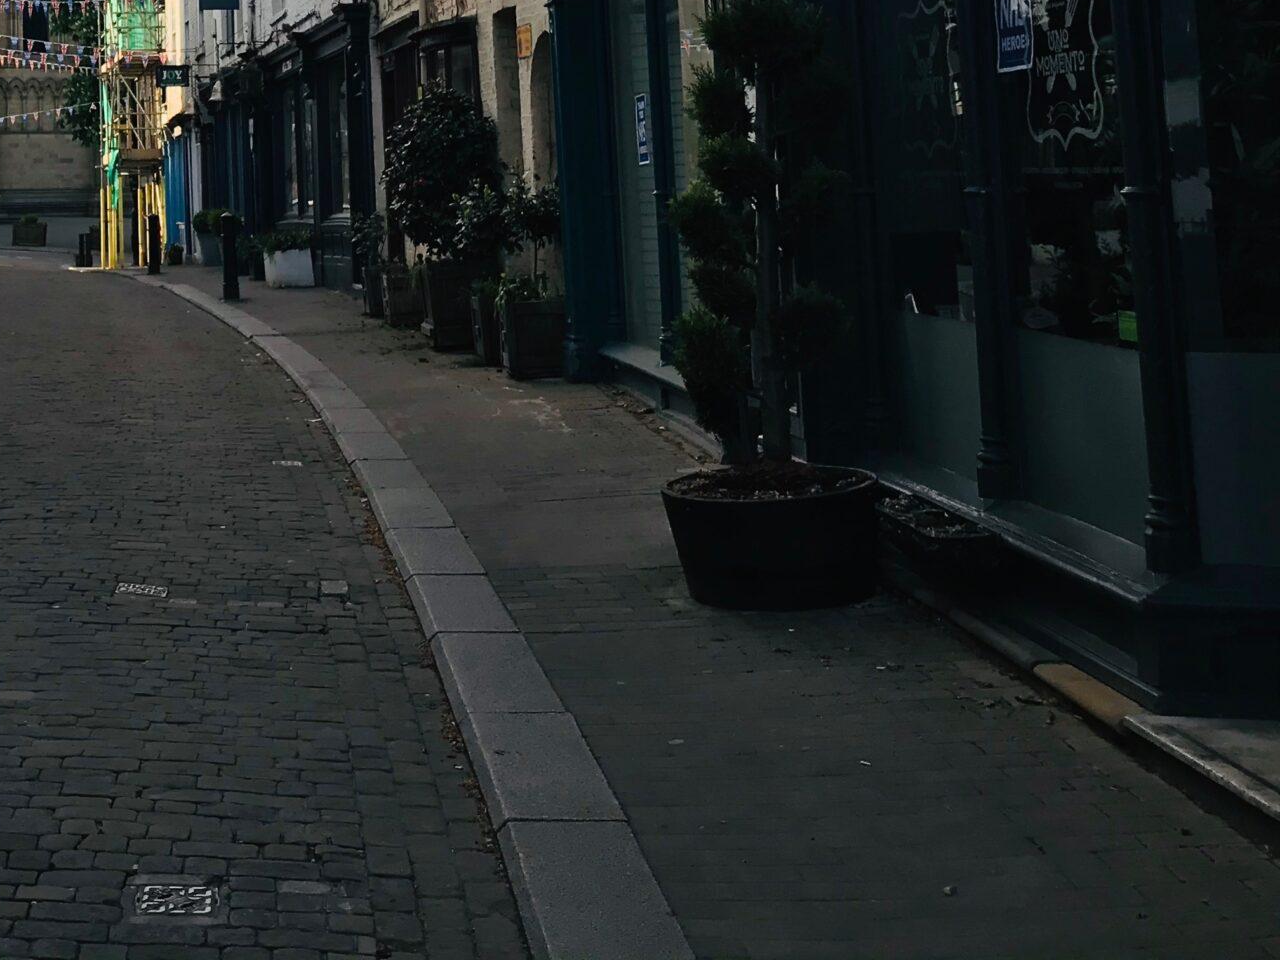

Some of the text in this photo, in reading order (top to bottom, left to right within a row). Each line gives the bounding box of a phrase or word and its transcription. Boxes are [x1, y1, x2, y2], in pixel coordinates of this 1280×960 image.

[1046, 27, 1070, 51] UNO
[161, 70, 183, 80] JOY
[1036, 49, 1086, 78] MOMENTO
